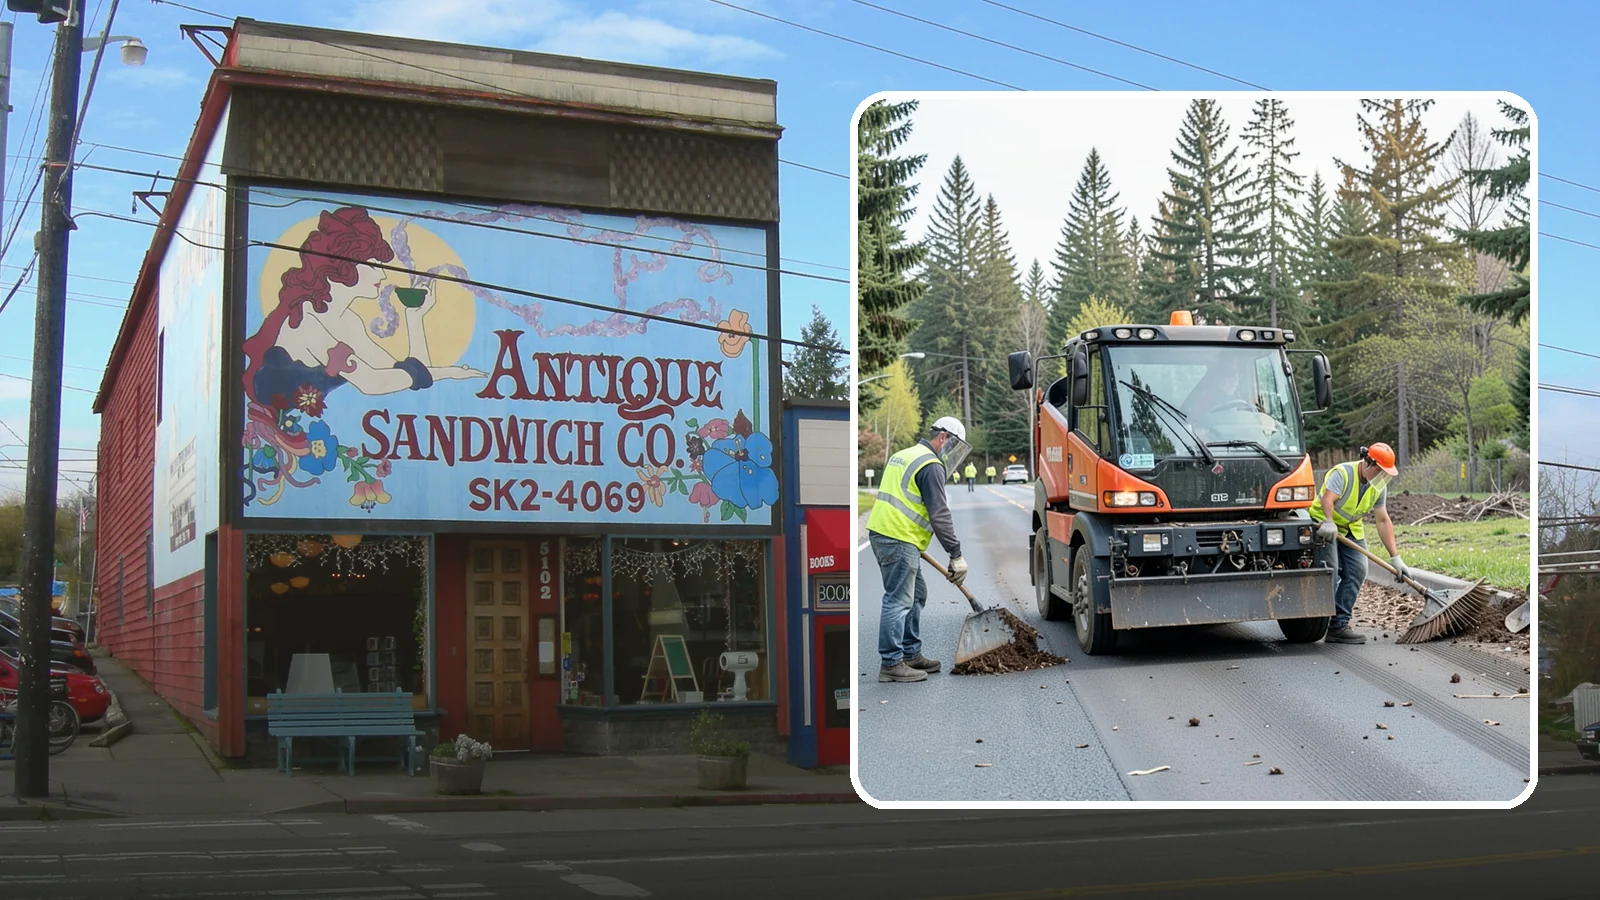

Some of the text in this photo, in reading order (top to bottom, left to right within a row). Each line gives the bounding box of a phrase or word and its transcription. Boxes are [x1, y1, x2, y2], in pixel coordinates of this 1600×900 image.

[476, 330, 723, 420] ANTIQUE
[361, 409, 685, 469] SANDWICH CO.
[468, 477, 645, 513] SK2-4069
[539, 541, 552, 599] 5102
[809, 555, 835, 569] BOOKS
